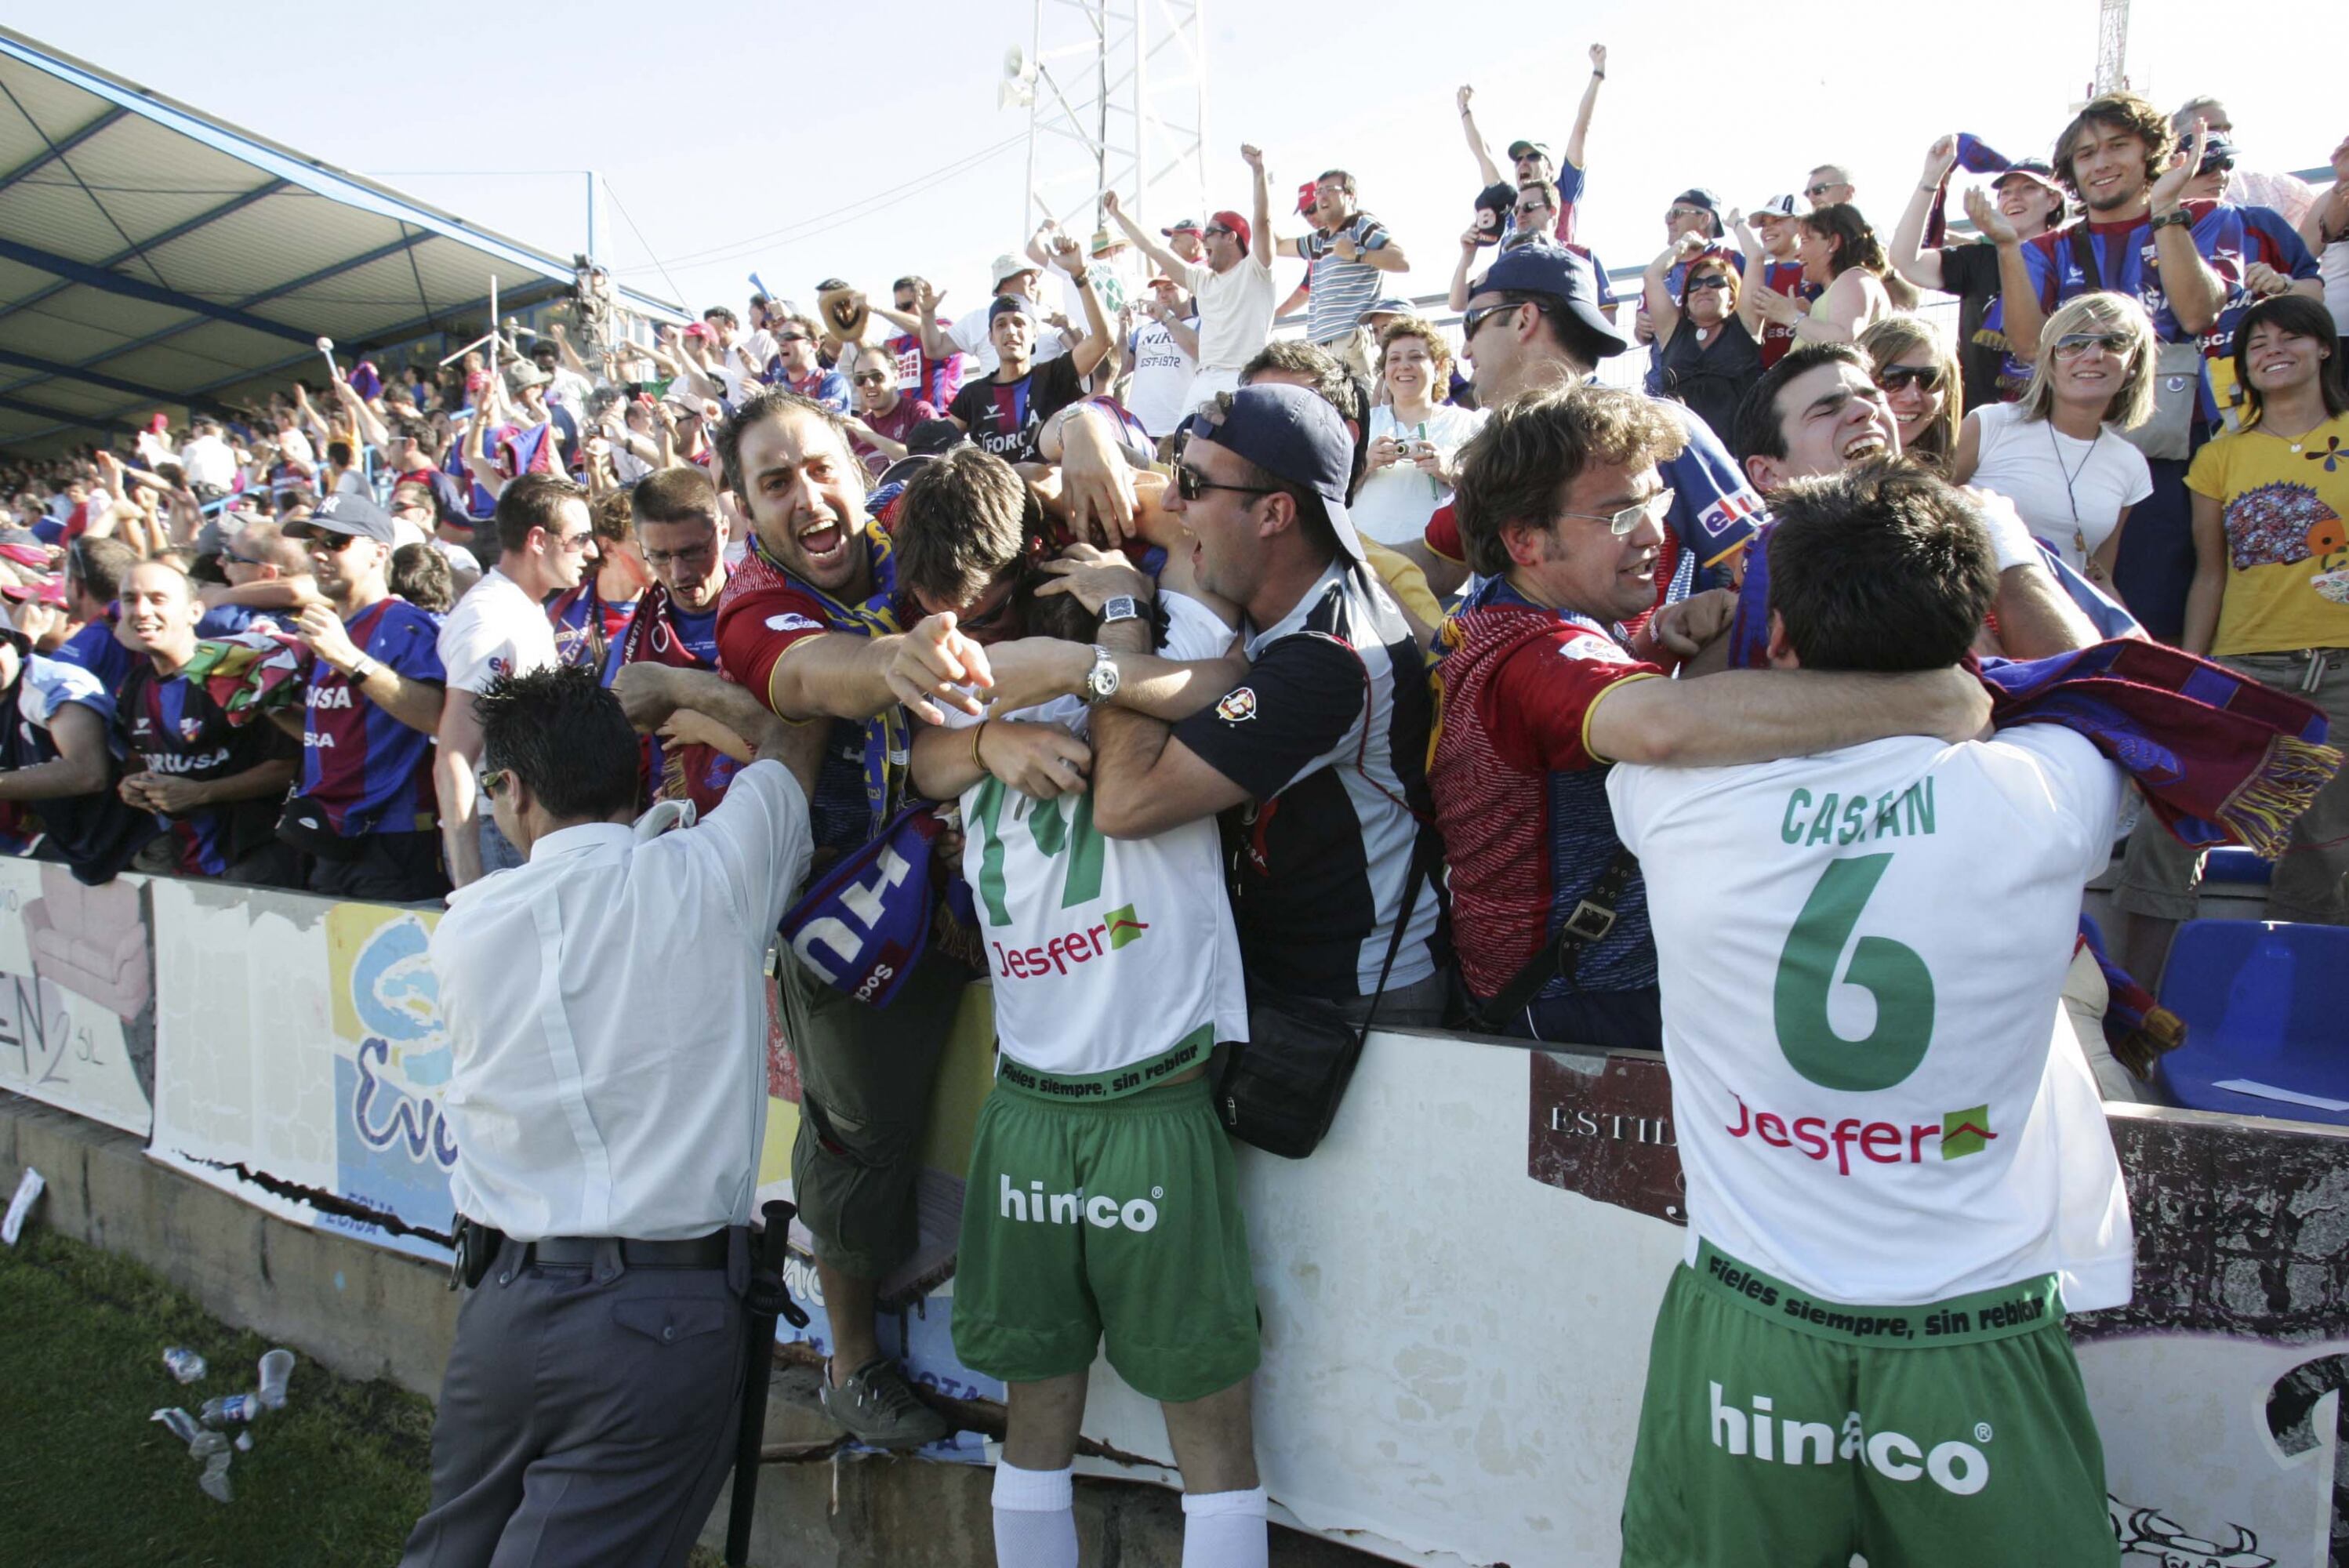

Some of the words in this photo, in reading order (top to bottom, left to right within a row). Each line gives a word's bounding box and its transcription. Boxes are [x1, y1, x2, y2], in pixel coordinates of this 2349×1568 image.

[993, 921, 1107, 979] Jesfer
[1774, 852, 1935, 1091] 6
[1112, 1073, 1141, 1092] sin
[1726, 1090, 1941, 1176] Jesfer
[1709, 1255, 1780, 1306] Fieles
[1925, 1308, 1970, 1336] sin
[1979, 1296, 2044, 1330] reblar
